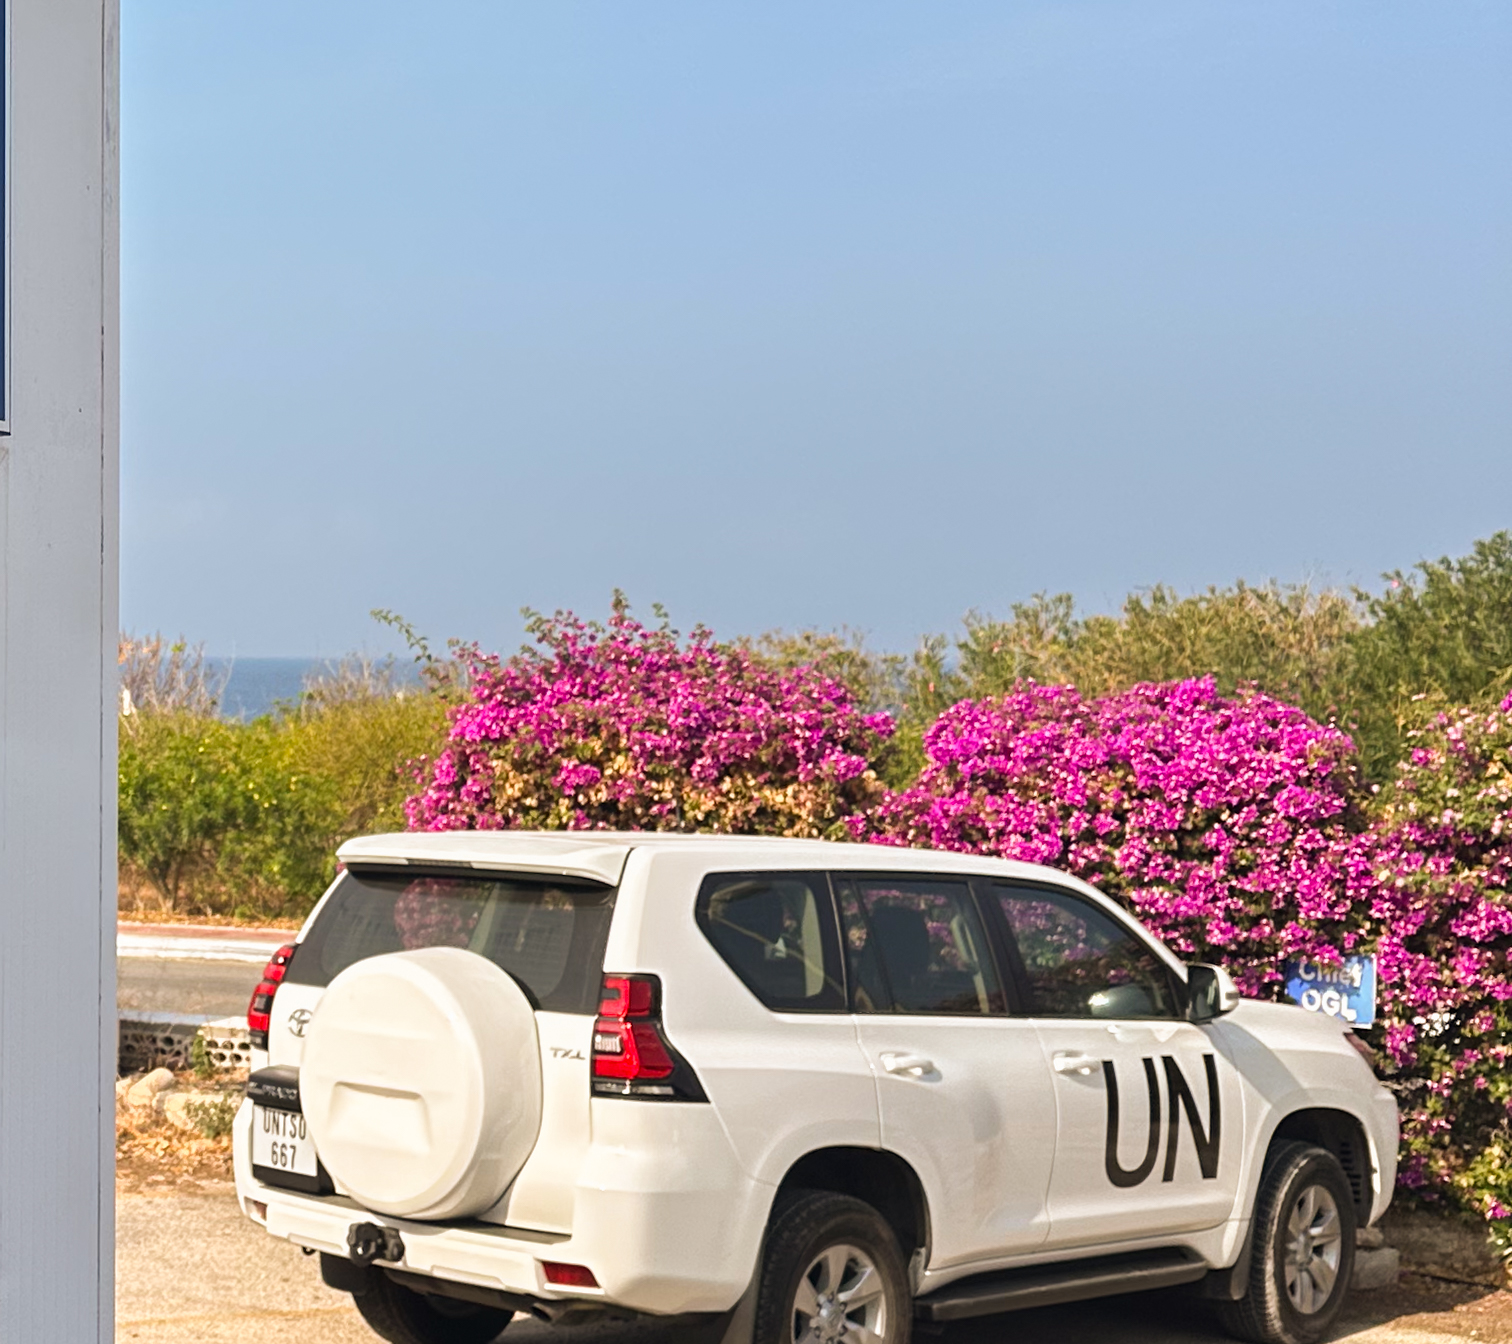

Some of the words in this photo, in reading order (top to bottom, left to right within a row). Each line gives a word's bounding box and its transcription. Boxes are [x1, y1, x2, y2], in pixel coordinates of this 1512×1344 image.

[1302, 989, 1357, 1022] OGL
[263, 1109, 306, 1140] UNTSO
[1103, 1054, 1222, 1188] UN
[271, 1141, 297, 1170] 667
